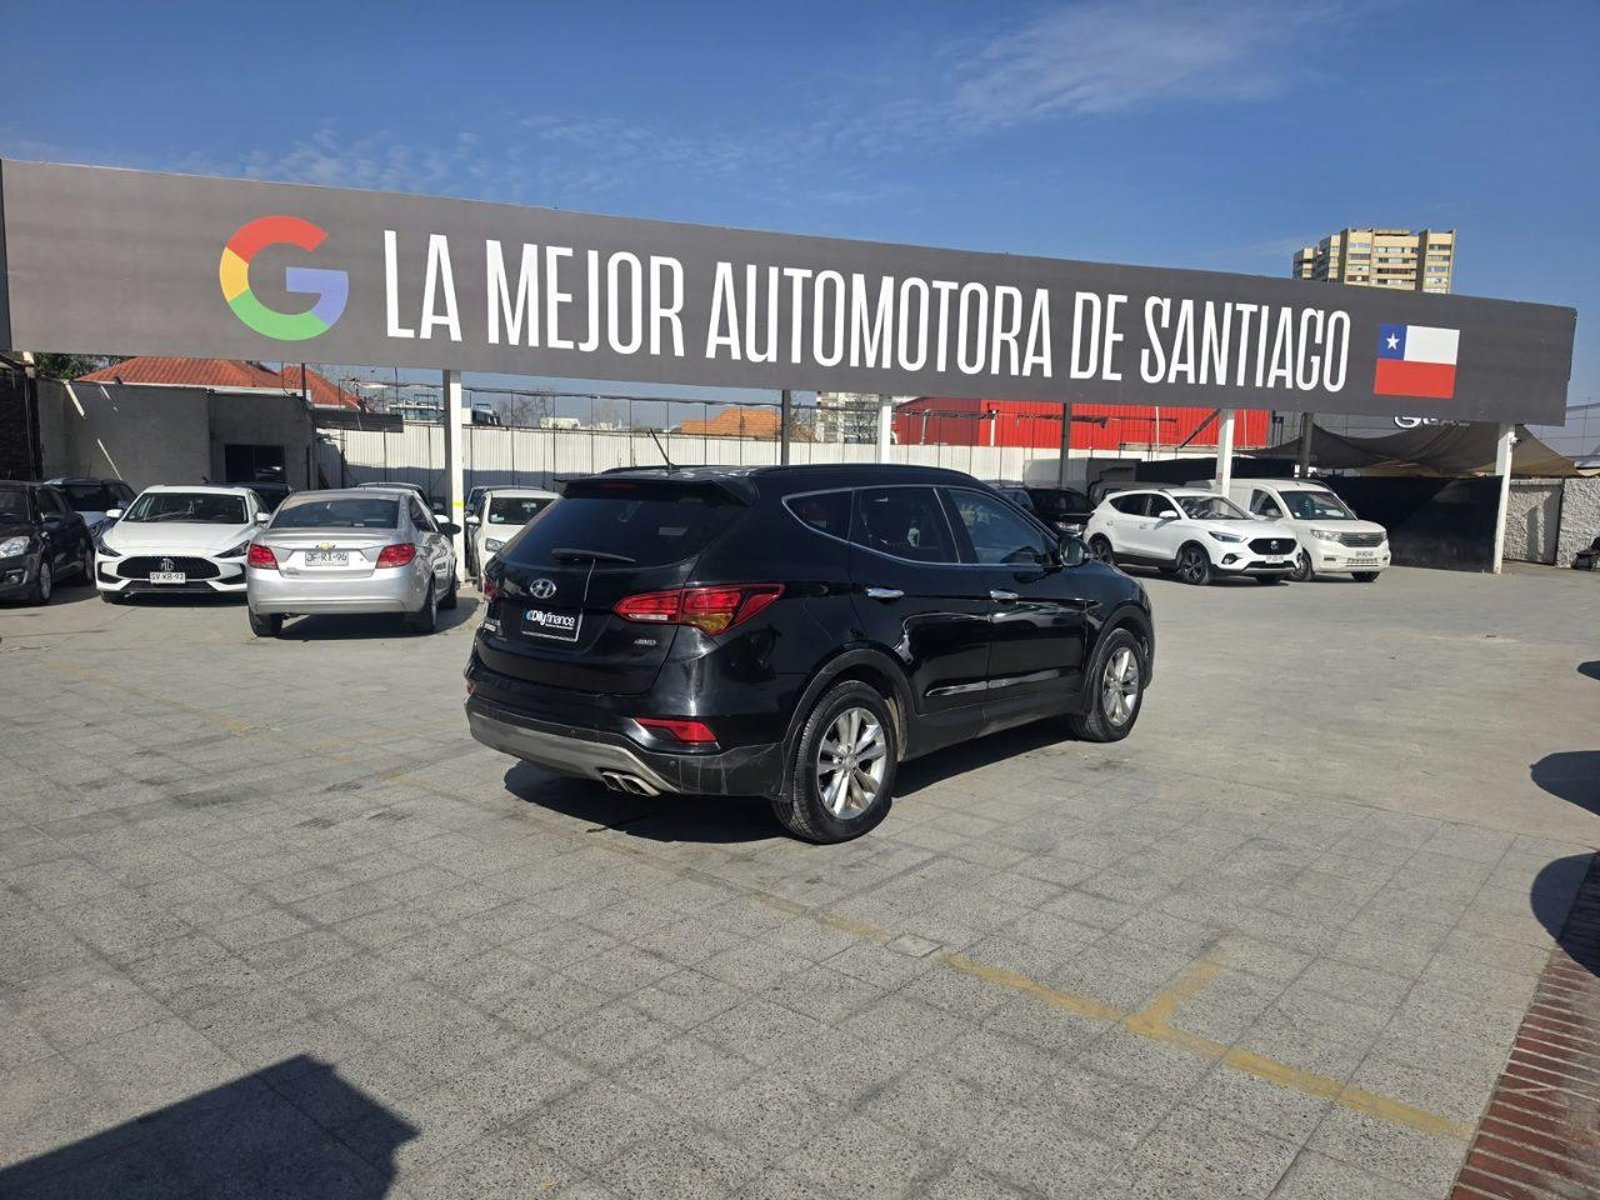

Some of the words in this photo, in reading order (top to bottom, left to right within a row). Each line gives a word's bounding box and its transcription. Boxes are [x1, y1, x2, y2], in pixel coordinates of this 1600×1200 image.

[384, 229, 463, 342] LA
[485, 239, 685, 357] MEJOR
[705, 261, 1052, 378] AUTOMOTORA
[1069, 291, 1128, 381] DE
[1140, 295, 1351, 392] SANTIAGO
